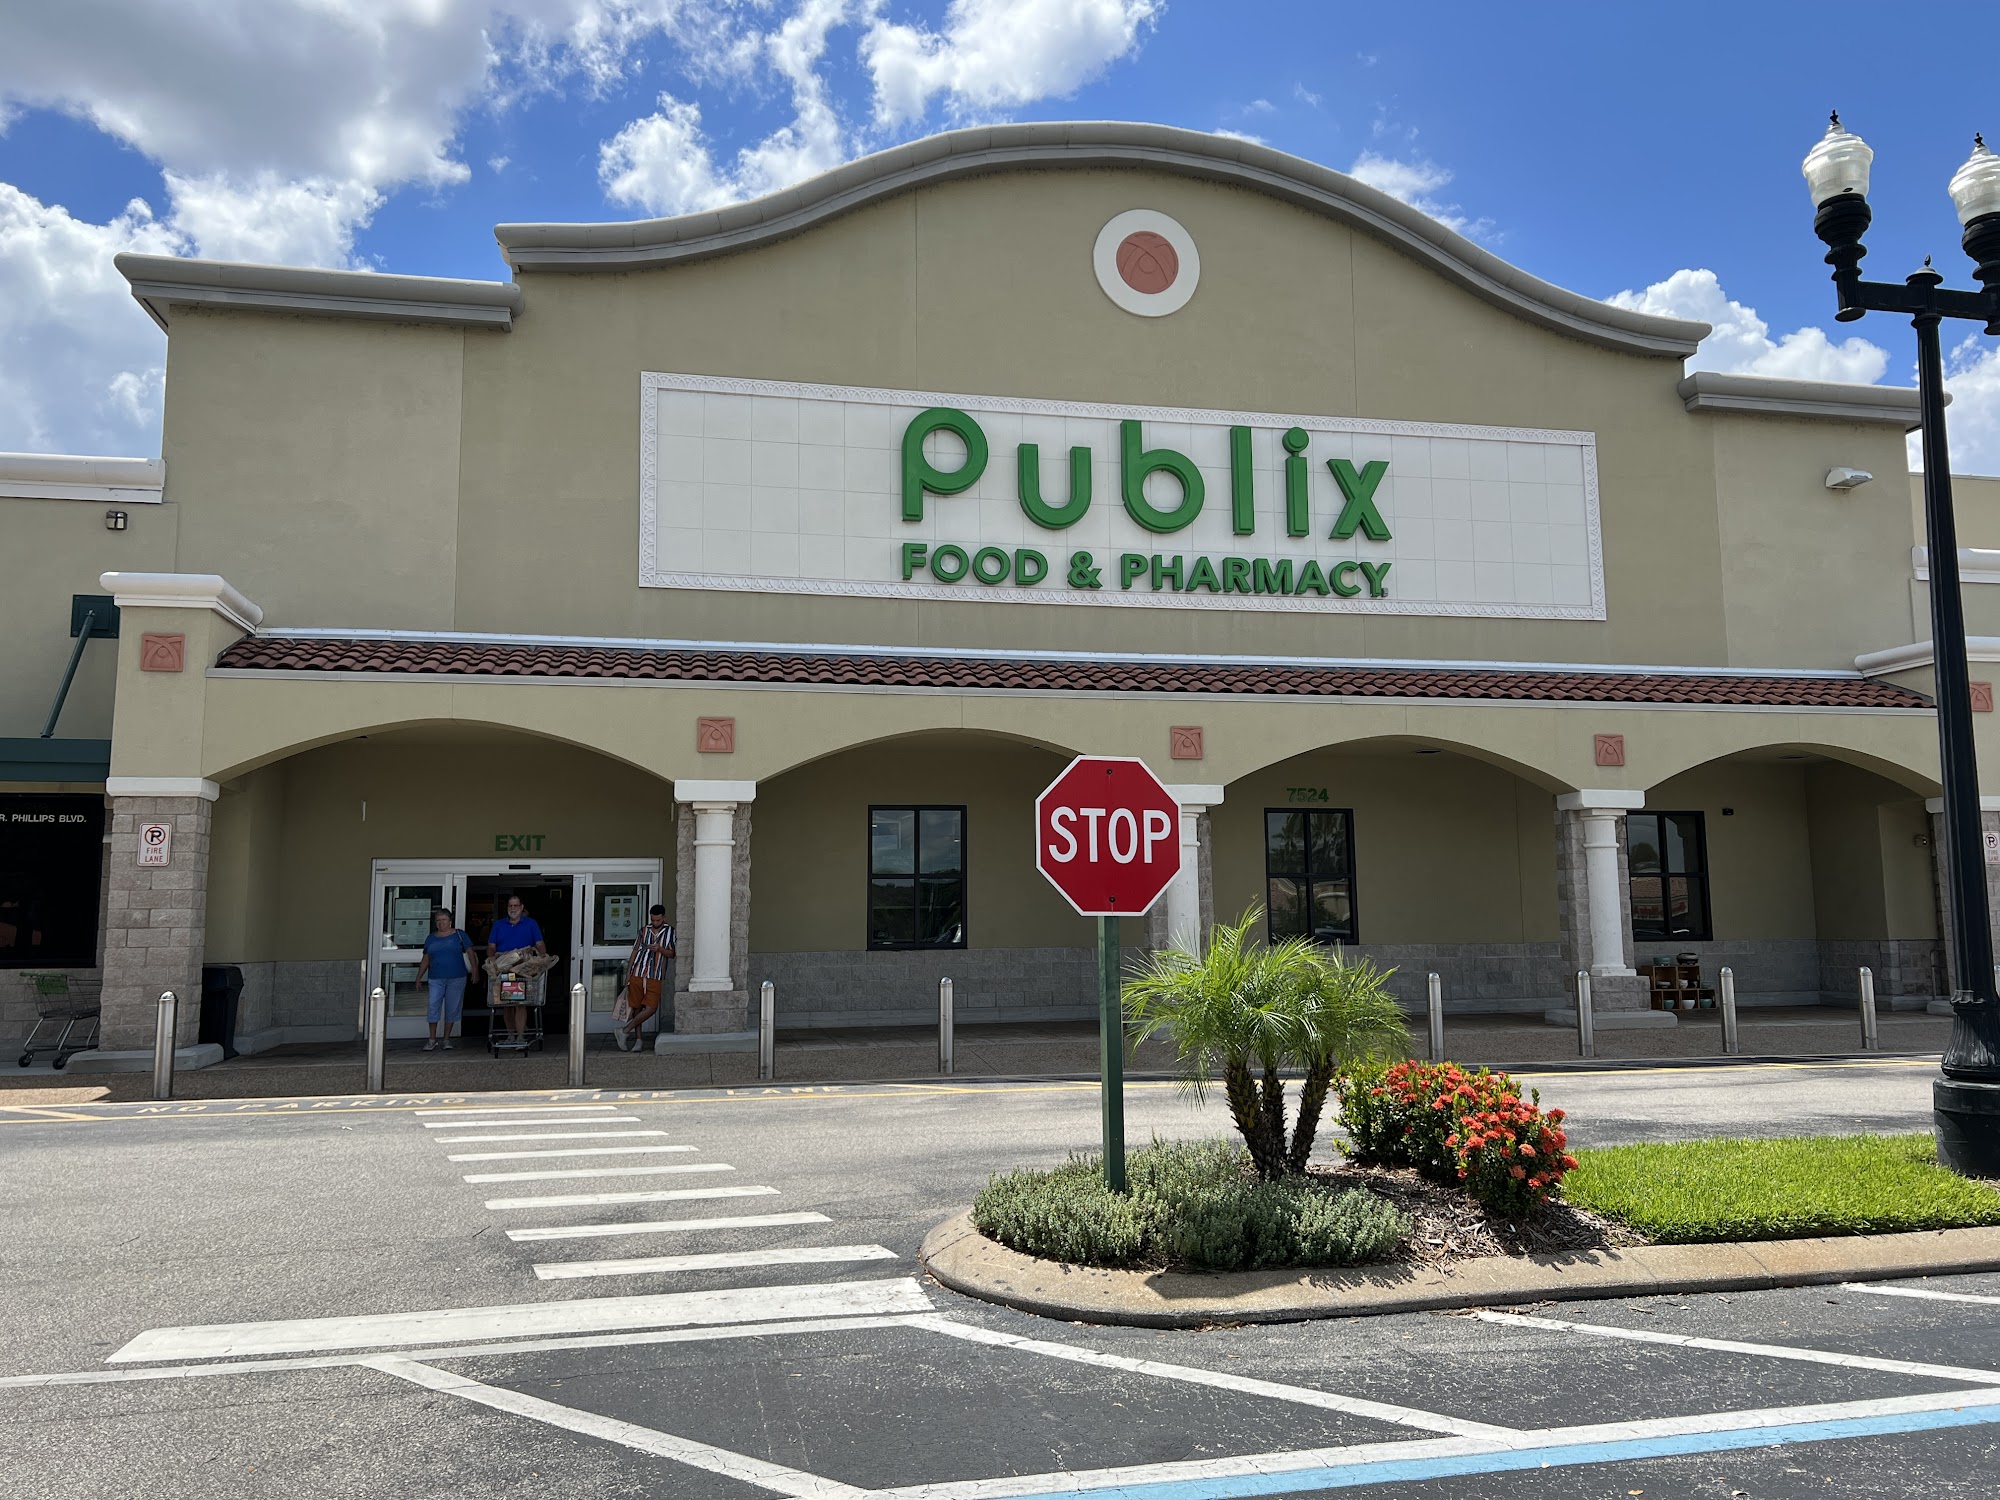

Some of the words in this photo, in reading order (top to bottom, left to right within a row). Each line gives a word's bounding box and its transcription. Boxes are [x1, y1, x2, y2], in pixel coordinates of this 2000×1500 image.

[902, 407, 1392, 541] Publix
[902, 543, 1048, 585] FOOD
[1067, 551, 1103, 589] &
[1120, 553, 1392, 598] PHARMACY
[1287, 788, 1329, 802] 7524
[12, 814, 55, 823] PHILLIPS
[59, 814, 87, 823] BLVD.
[495, 834, 546, 851] EXIT
[1048, 806, 1172, 864] STOP
[146, 847, 163, 855] FIRE
[136, 1105, 208, 1114] NO
[235, 1098, 466, 1110] PARKING
[550, 1092, 675, 1101] FIRE
[726, 1087, 847, 1096] LANE
